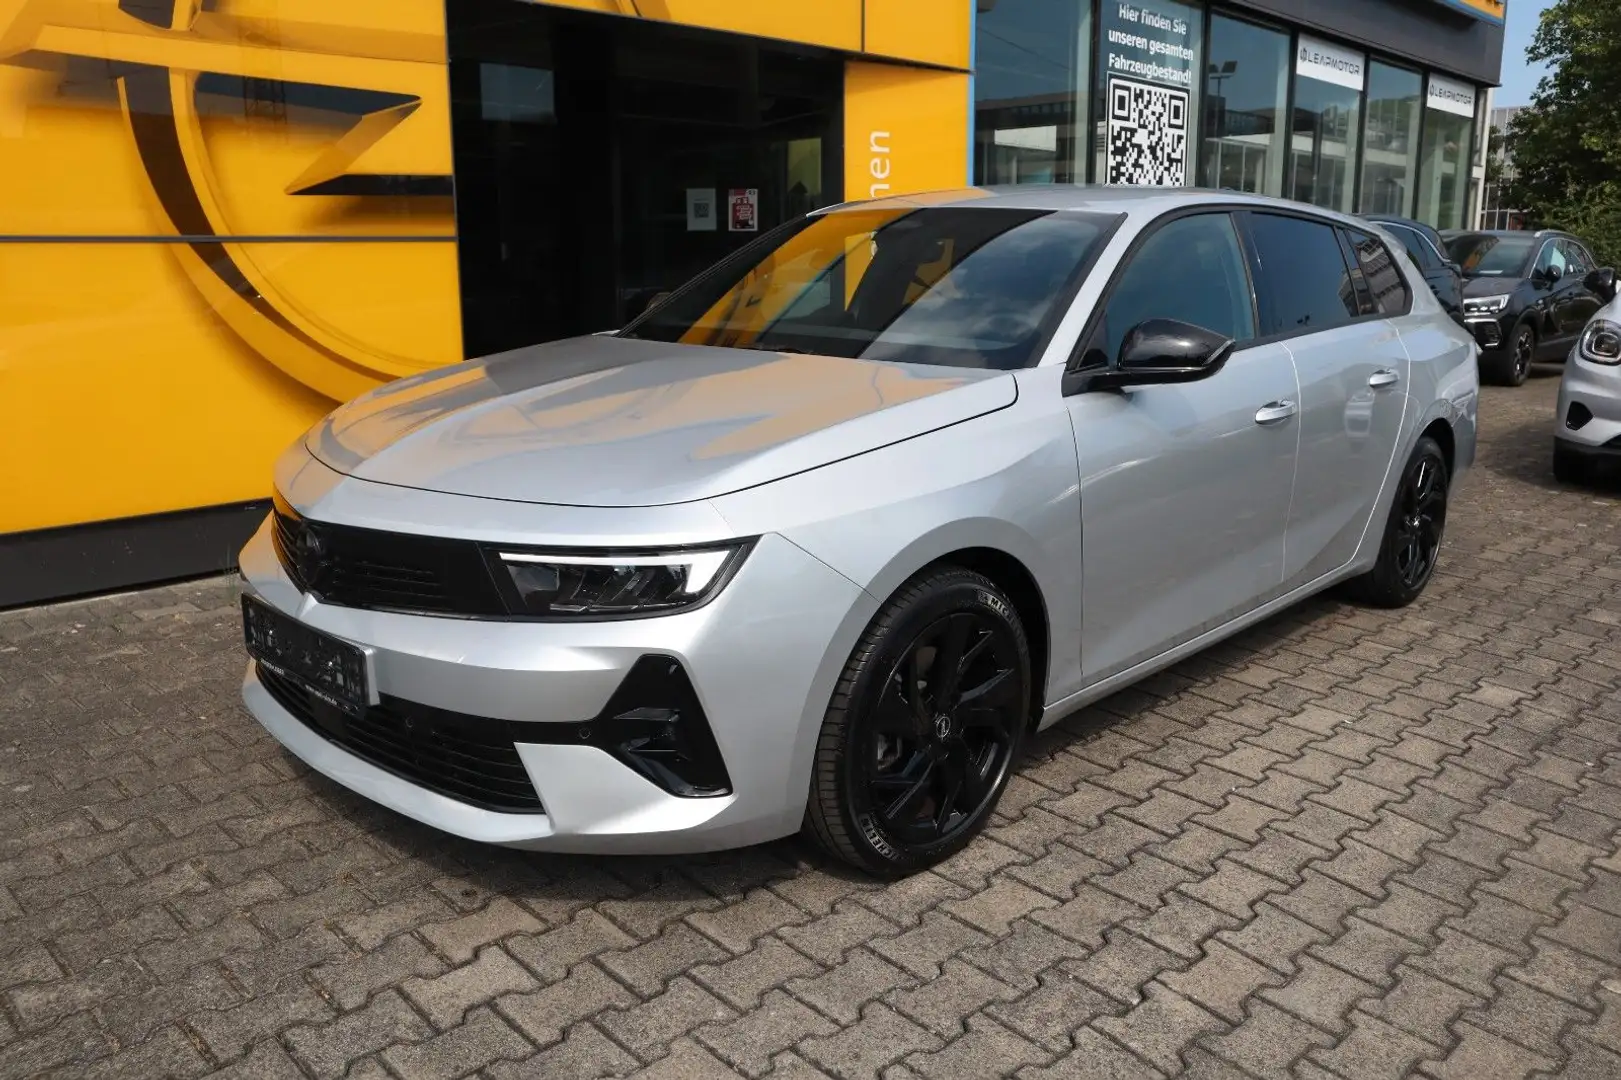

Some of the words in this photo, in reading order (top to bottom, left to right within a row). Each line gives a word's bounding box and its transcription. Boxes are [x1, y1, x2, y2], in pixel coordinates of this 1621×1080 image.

[1119, 4, 1139, 21] Hier
[1141, 9, 1171, 31] finden
[1173, 19, 1186, 35] Sie
[1108, 30, 1147, 49] unseren
[1149, 39, 1194, 60] gesamten
[1108, 53, 1191, 83] Fahrzeugbestand!
[1307, 52, 1360, 75] LEAPMOTOR
